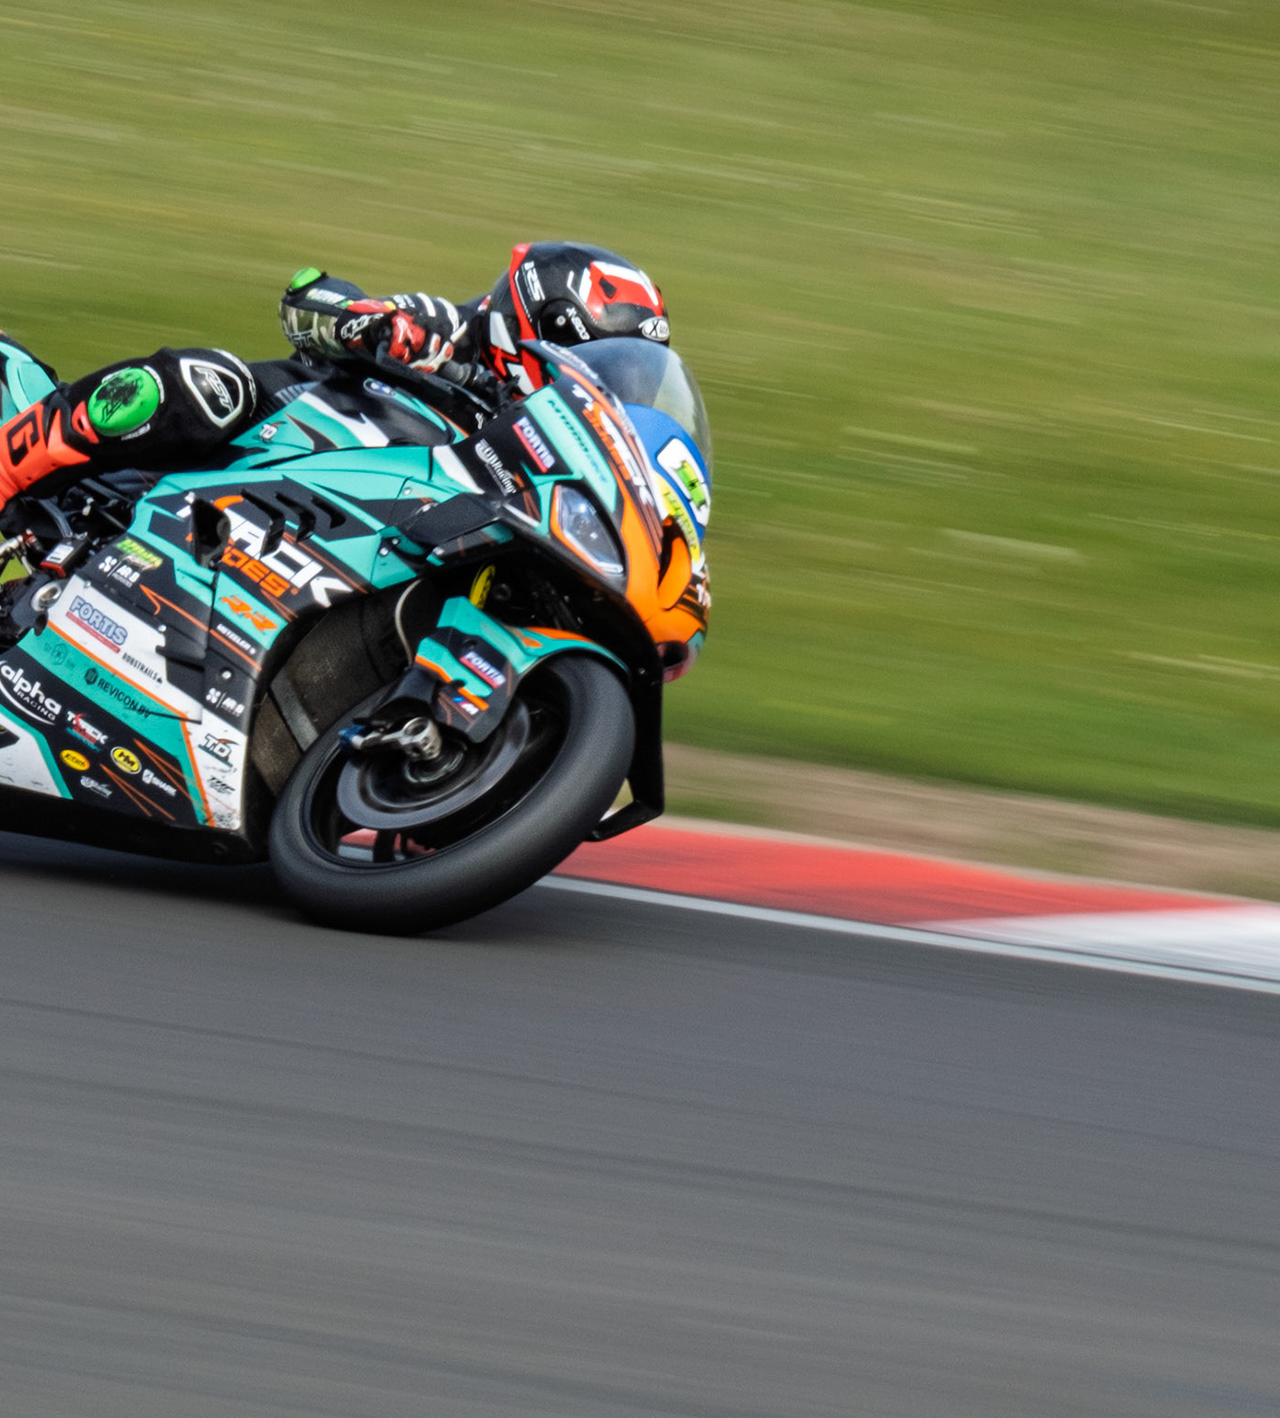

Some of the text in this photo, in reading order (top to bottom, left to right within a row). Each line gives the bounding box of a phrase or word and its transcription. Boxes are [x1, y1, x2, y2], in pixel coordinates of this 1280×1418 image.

[517, 416, 555, 468] FORTIS
[69, 595, 128, 645] FORTIS
[0, 664, 62, 715] alpha
[464, 651, 506, 685] FORTIS
[16, 691, 56, 721] RACING
